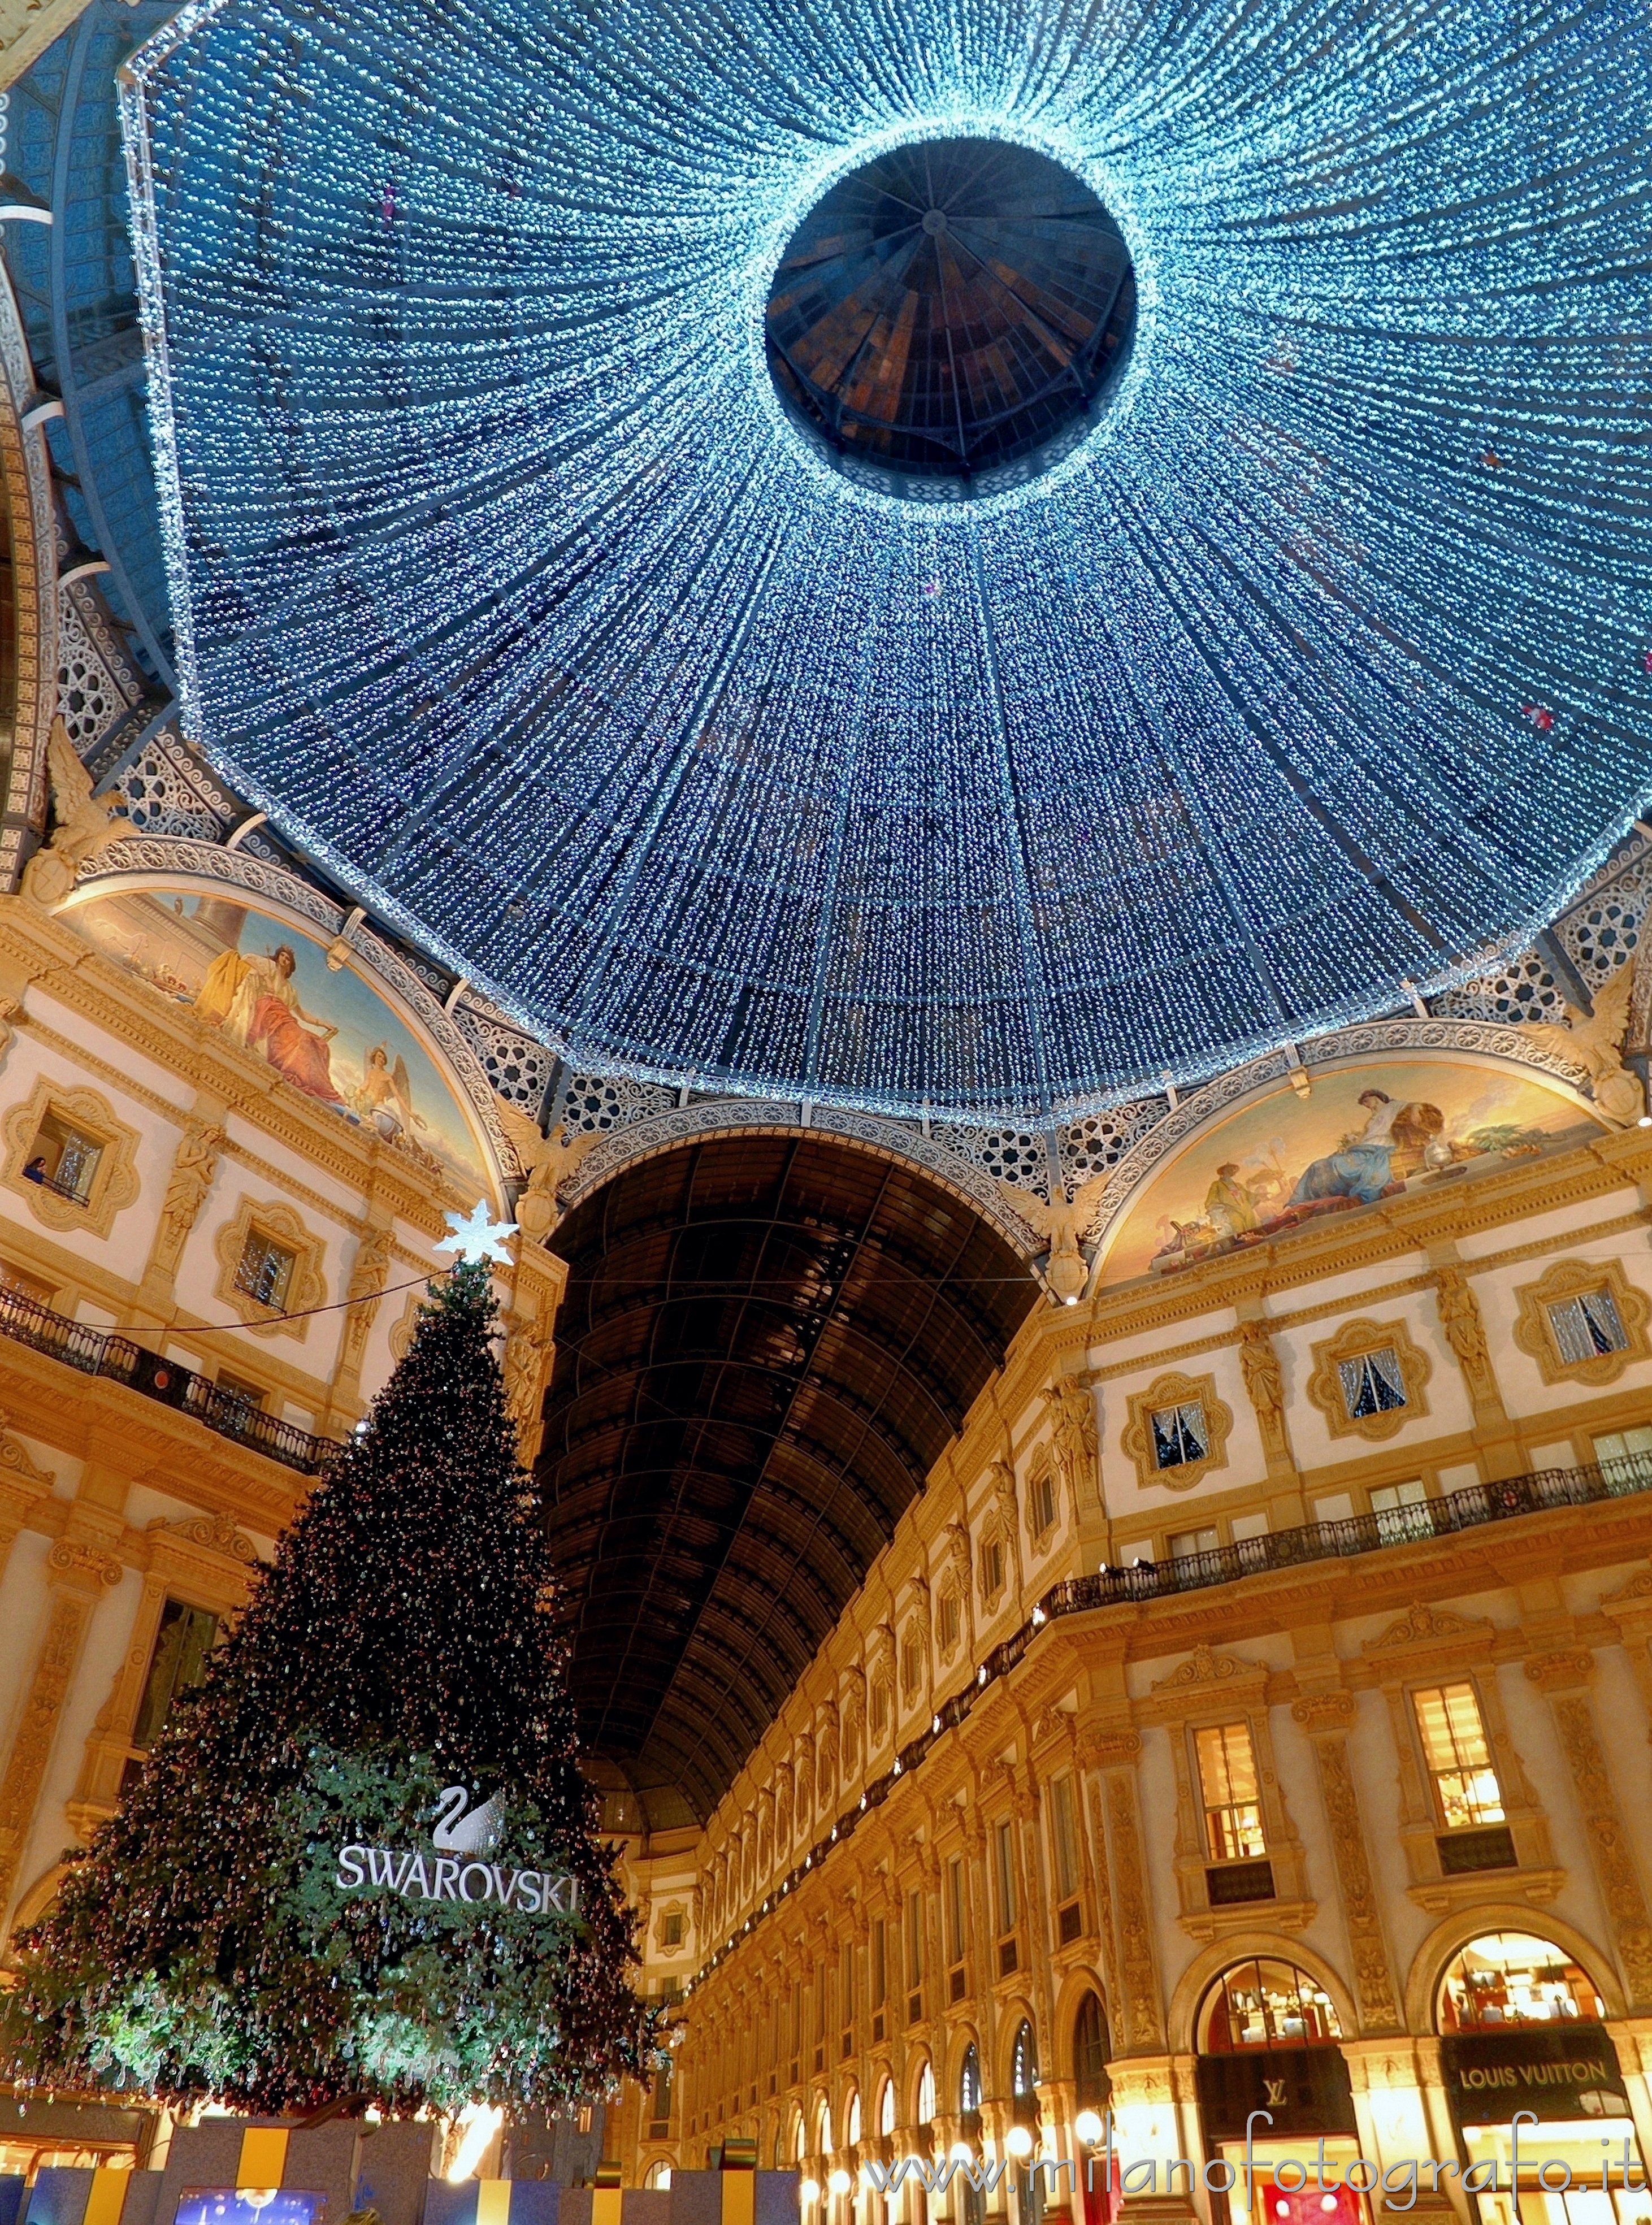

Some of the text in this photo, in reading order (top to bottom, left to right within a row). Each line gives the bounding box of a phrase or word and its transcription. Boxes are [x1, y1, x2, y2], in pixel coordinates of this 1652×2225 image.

[336, 1845, 579, 1914] SWAROVSKI
[1460, 2062, 1608, 2089] LOUIS VUITTON
